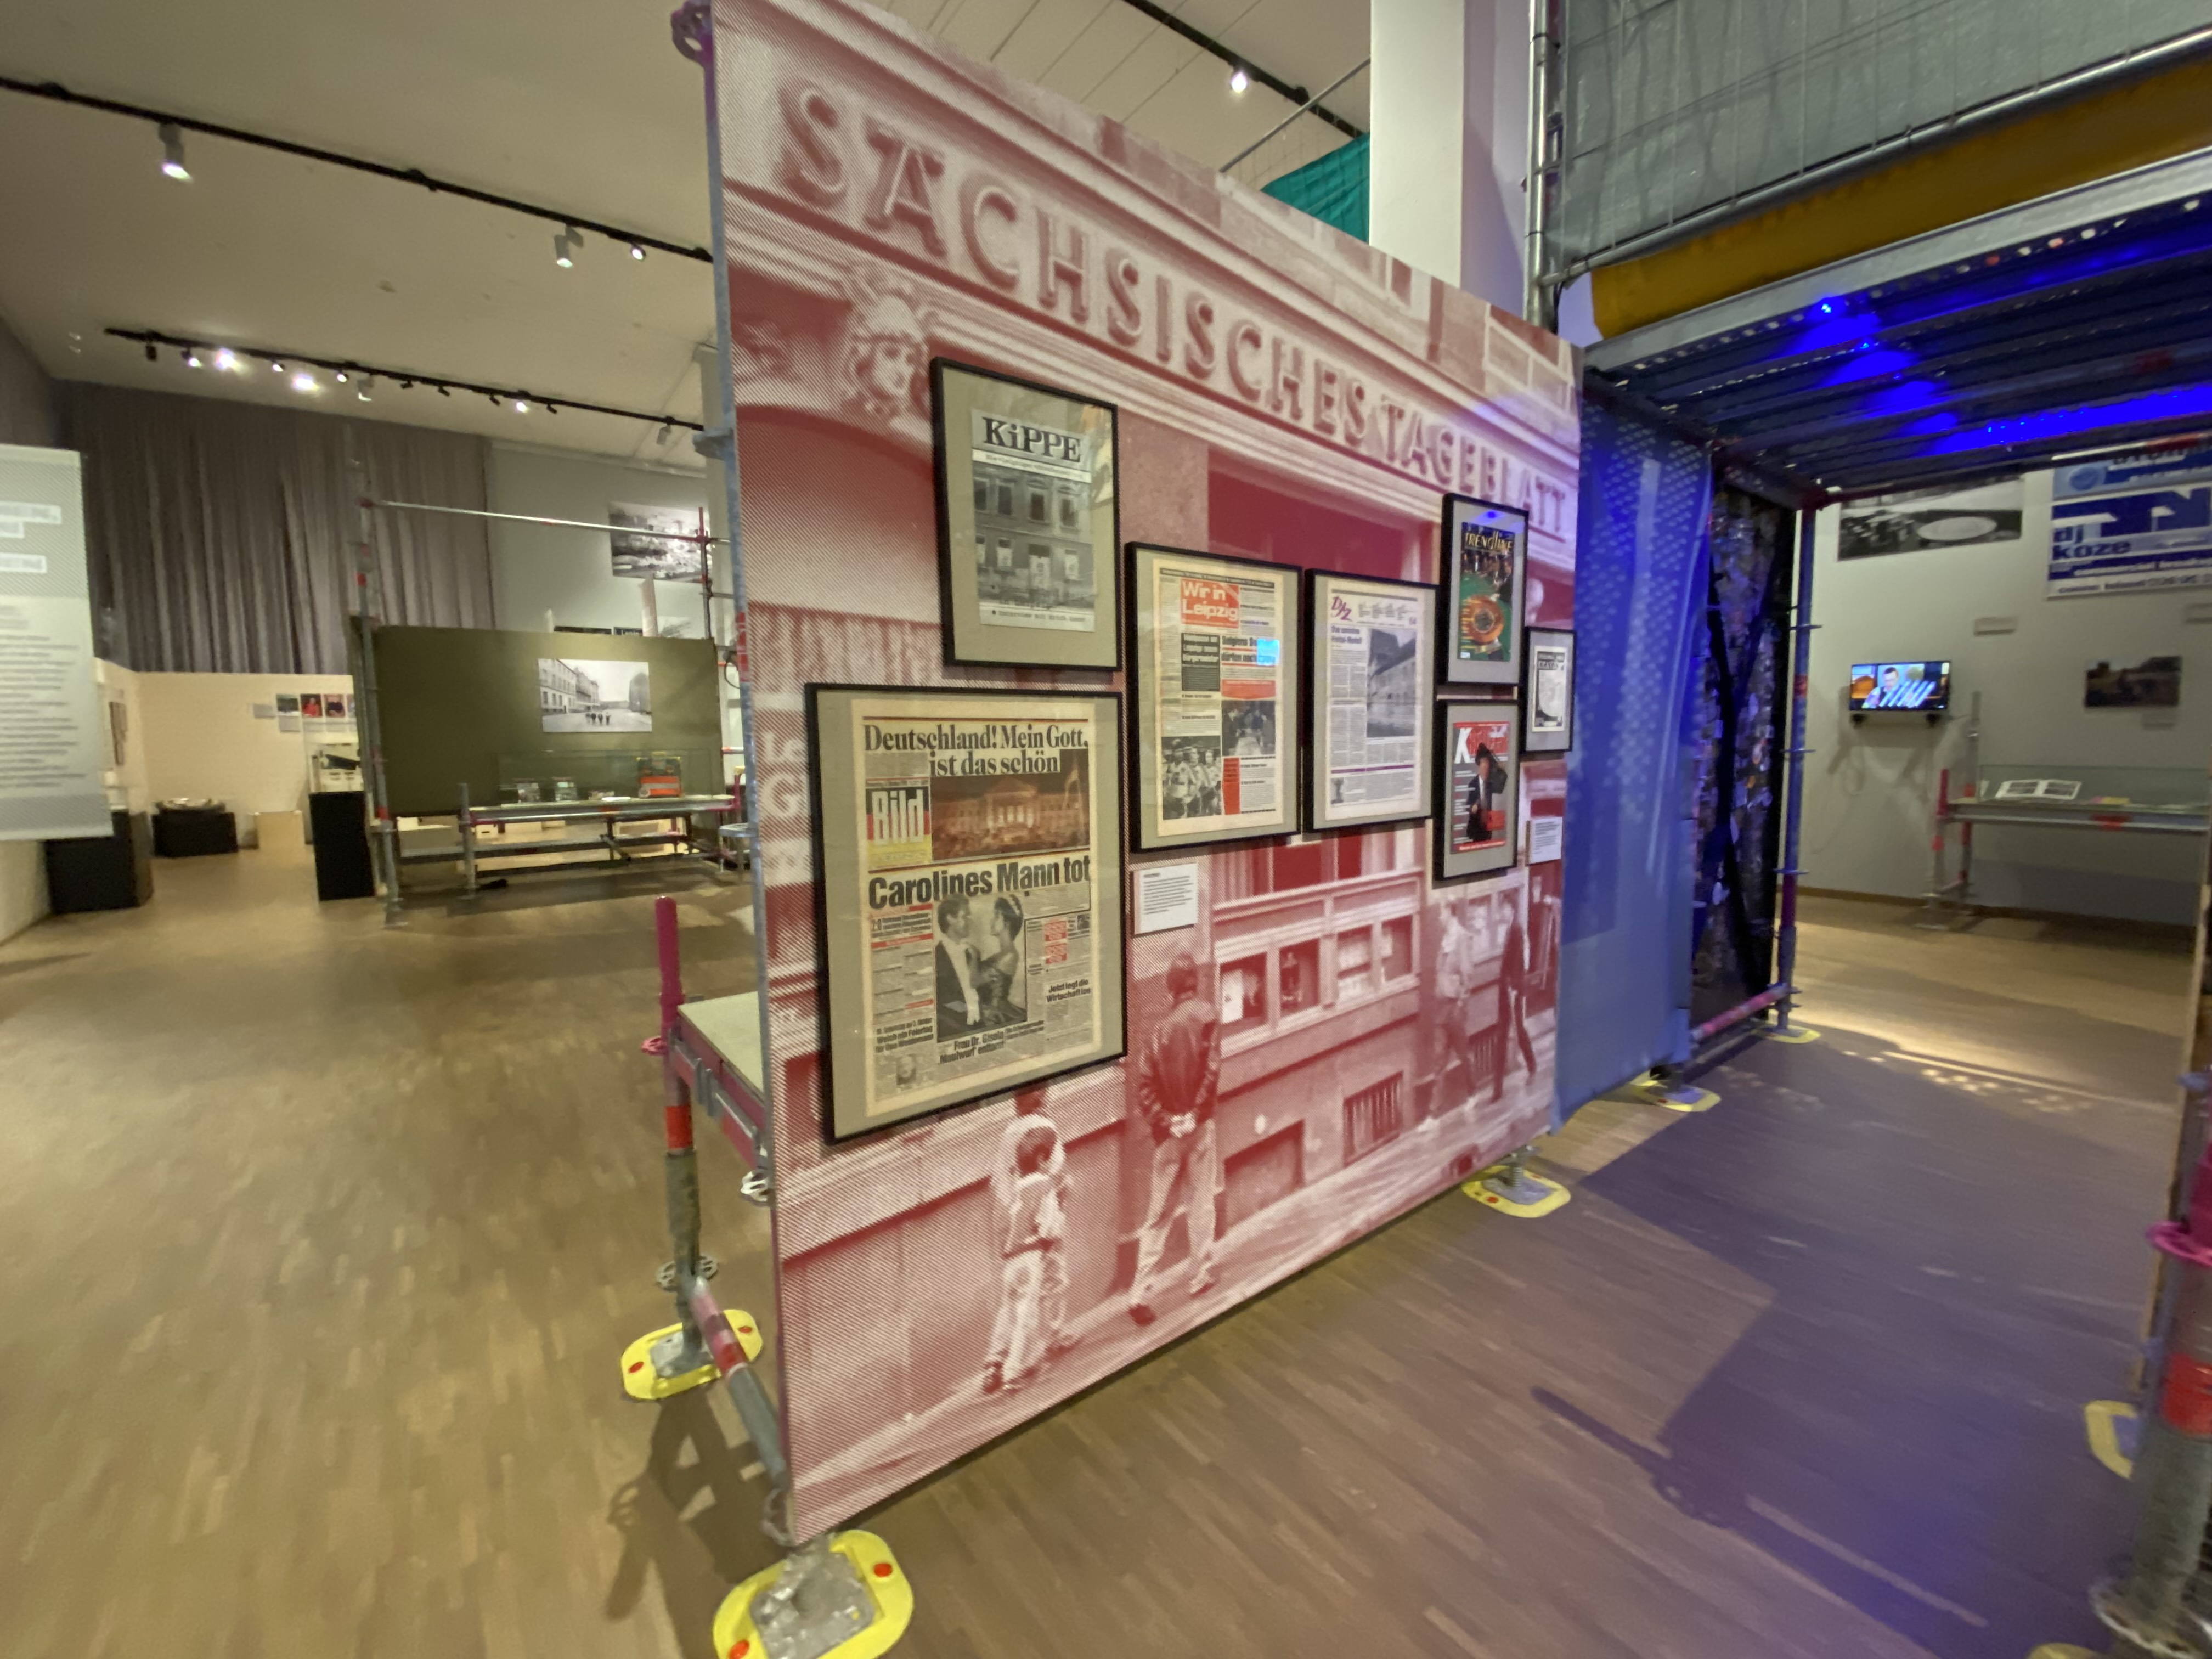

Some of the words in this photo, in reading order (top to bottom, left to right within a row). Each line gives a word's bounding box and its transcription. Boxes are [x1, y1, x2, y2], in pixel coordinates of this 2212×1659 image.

[1182, 580, 1210, 599] Wir
[1212, 584, 1226, 601] in
[1182, 599, 1238, 622] Leipzig
[864, 724, 997, 751] Deutschland!
[1001, 724, 1043, 748] Mein
[928, 751, 957, 776] ist
[961, 751, 997, 775] das
[1000, 749, 1058, 774] schön
[872, 789, 924, 845] Bild
[868, 870, 992, 909] Carolines
[997, 862, 1059, 893] Mann
[1063, 856, 1091, 883] tot
